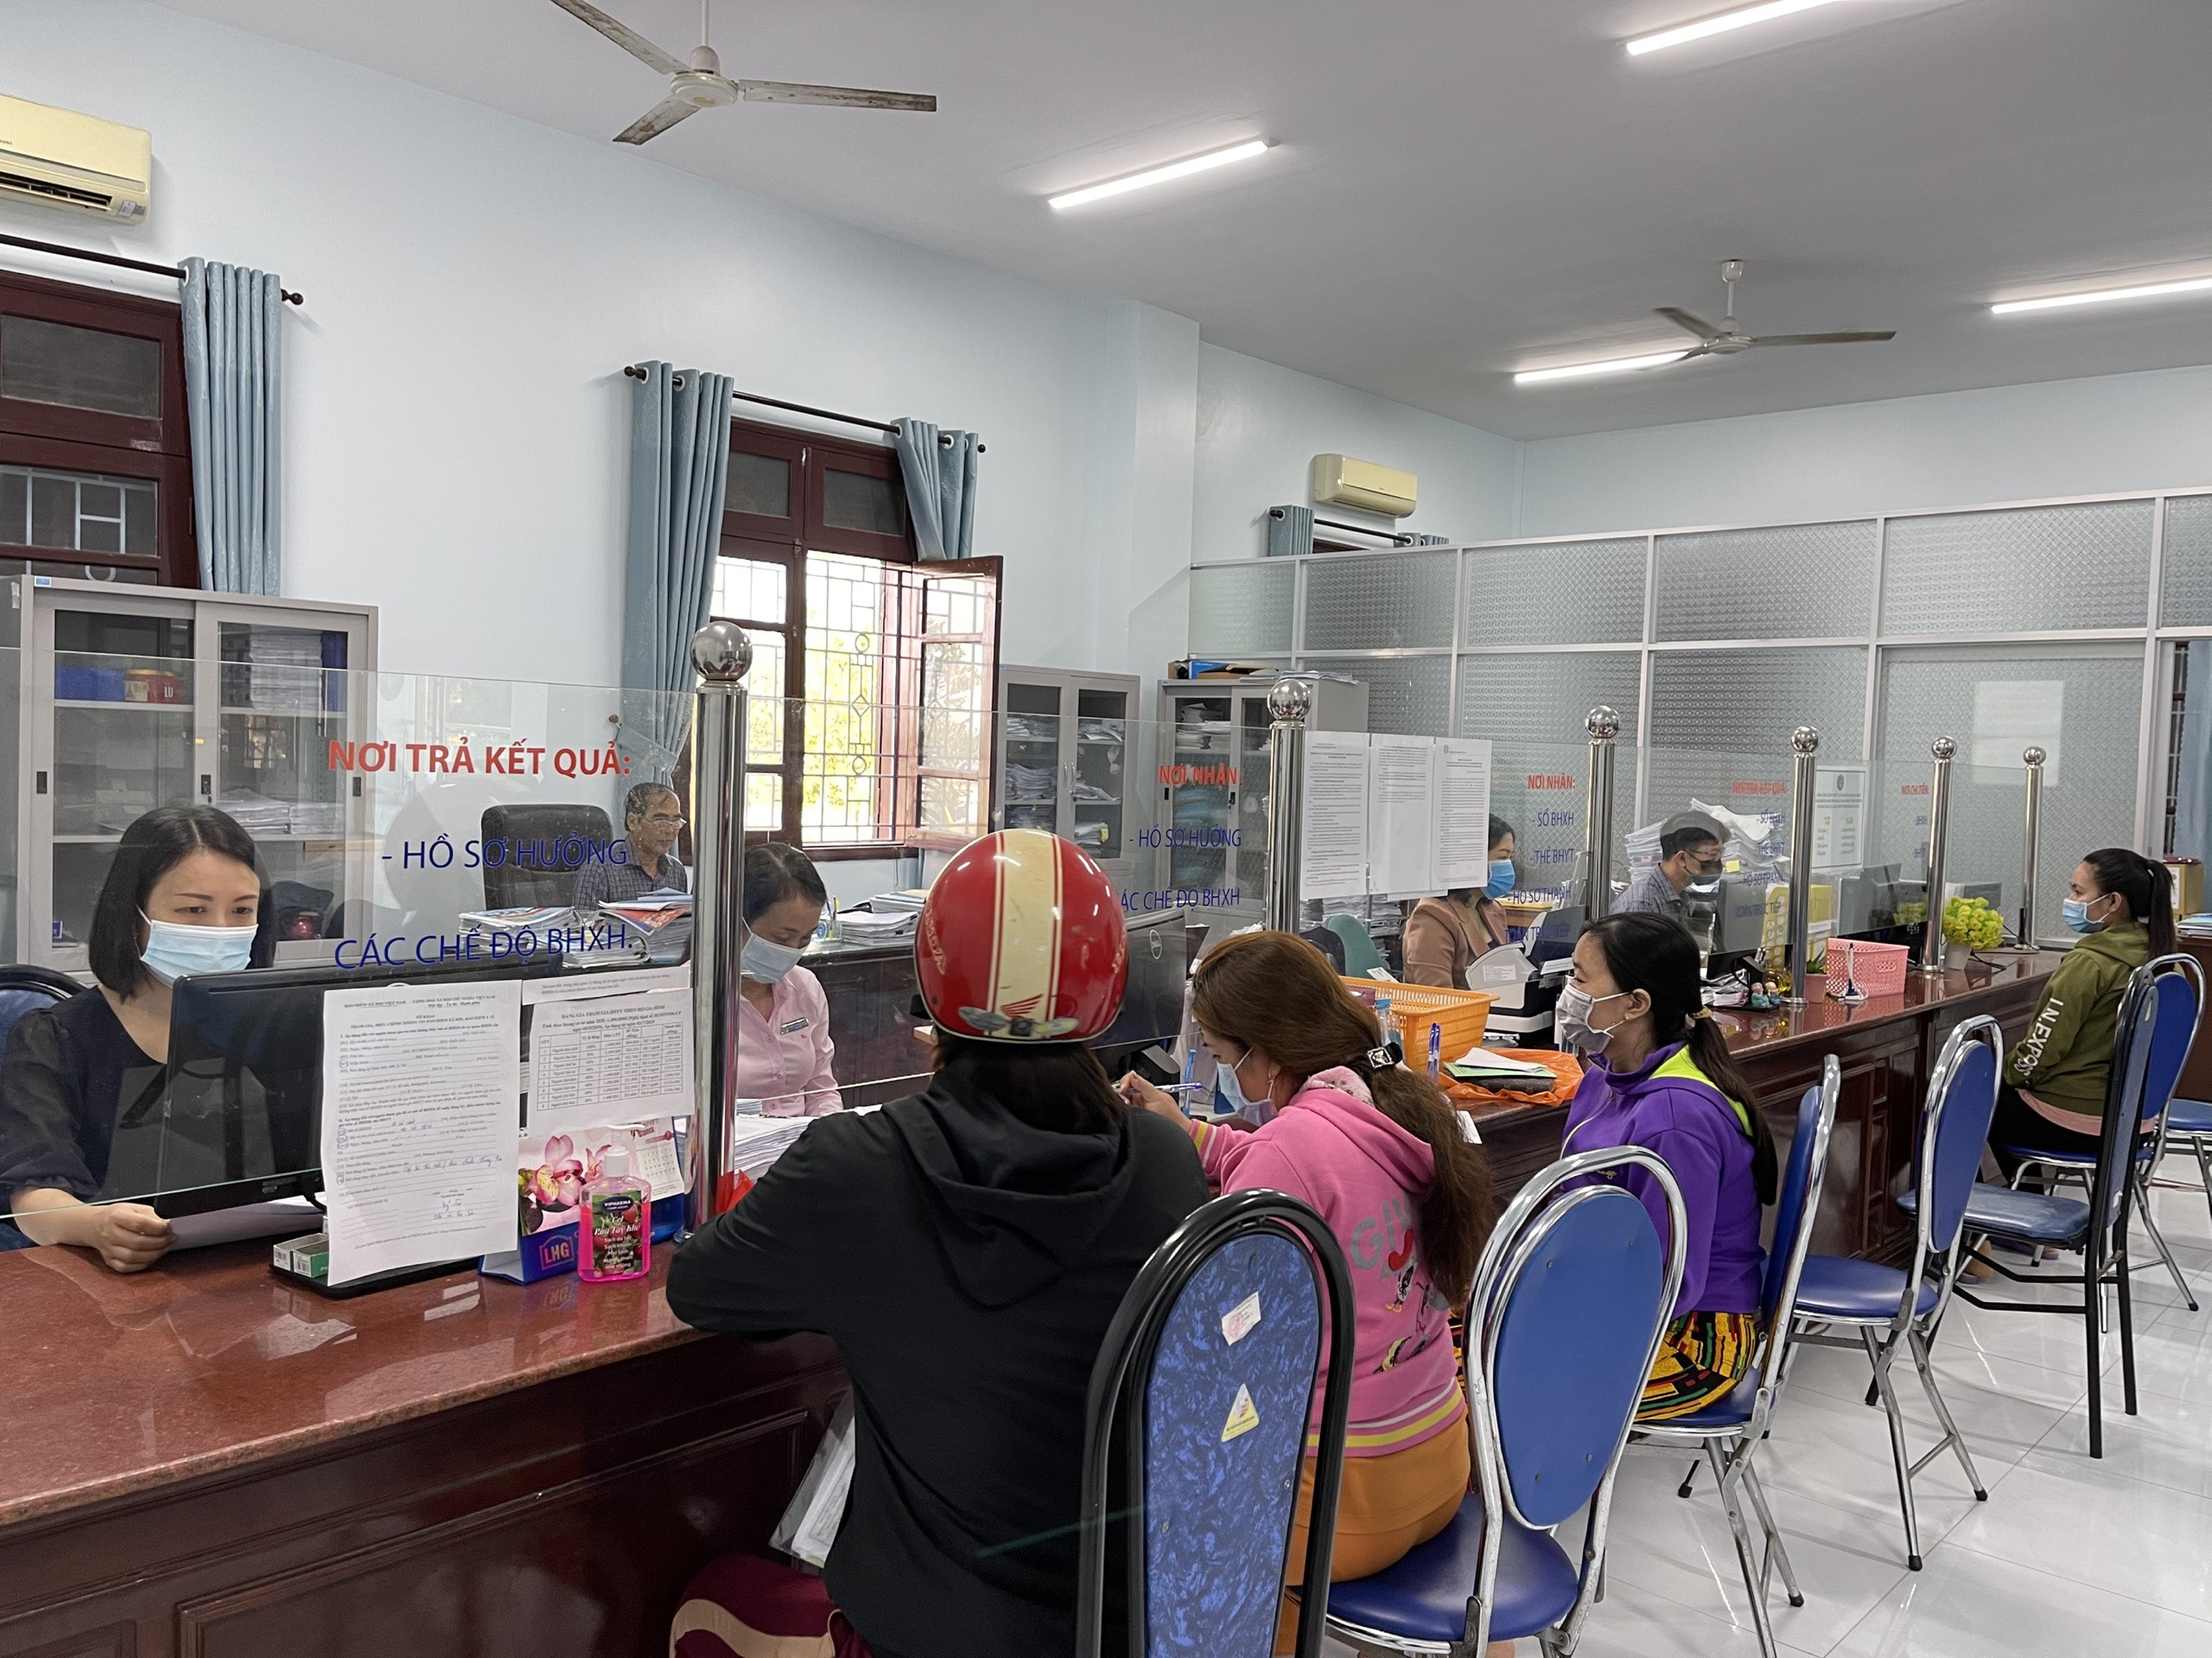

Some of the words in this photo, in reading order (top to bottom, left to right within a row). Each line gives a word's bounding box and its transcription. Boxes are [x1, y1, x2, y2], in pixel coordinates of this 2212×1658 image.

[328, 740, 396, 772] NƠI
[406, 736, 474, 773] TRẢ
[486, 738, 545, 774] KẾT
[554, 740, 632, 778] QUẢ:
[1159, 763, 1187, 785] NƠI
[1528, 774, 1545, 790] NƠI
[1551, 811, 1574, 827] BHXH
[1139, 823, 1161, 848] HỒ
[1165, 828, 1185, 847] SƠ
[1189, 823, 1242, 847] HƯỞNG
[404, 833, 454, 868] HỒ
[464, 837, 507, 867] SƠ
[516, 832, 626, 866] HƯỞNG
[1553, 848, 1574, 864] BHYT
[1121, 889, 1139, 912] ÁC
[1176, 886, 1198, 912] ĐỘ
[1203, 888, 1240, 907] BHXH
[1542, 886, 1572, 902] THANH
[334, 933, 405, 969] CÁC
[416, 924, 483, 964] CHẾ
[490, 926, 537, 964] ĐỘ
[547, 924, 632, 955] BHXH.
[544, 1242, 569, 1263] LHG
